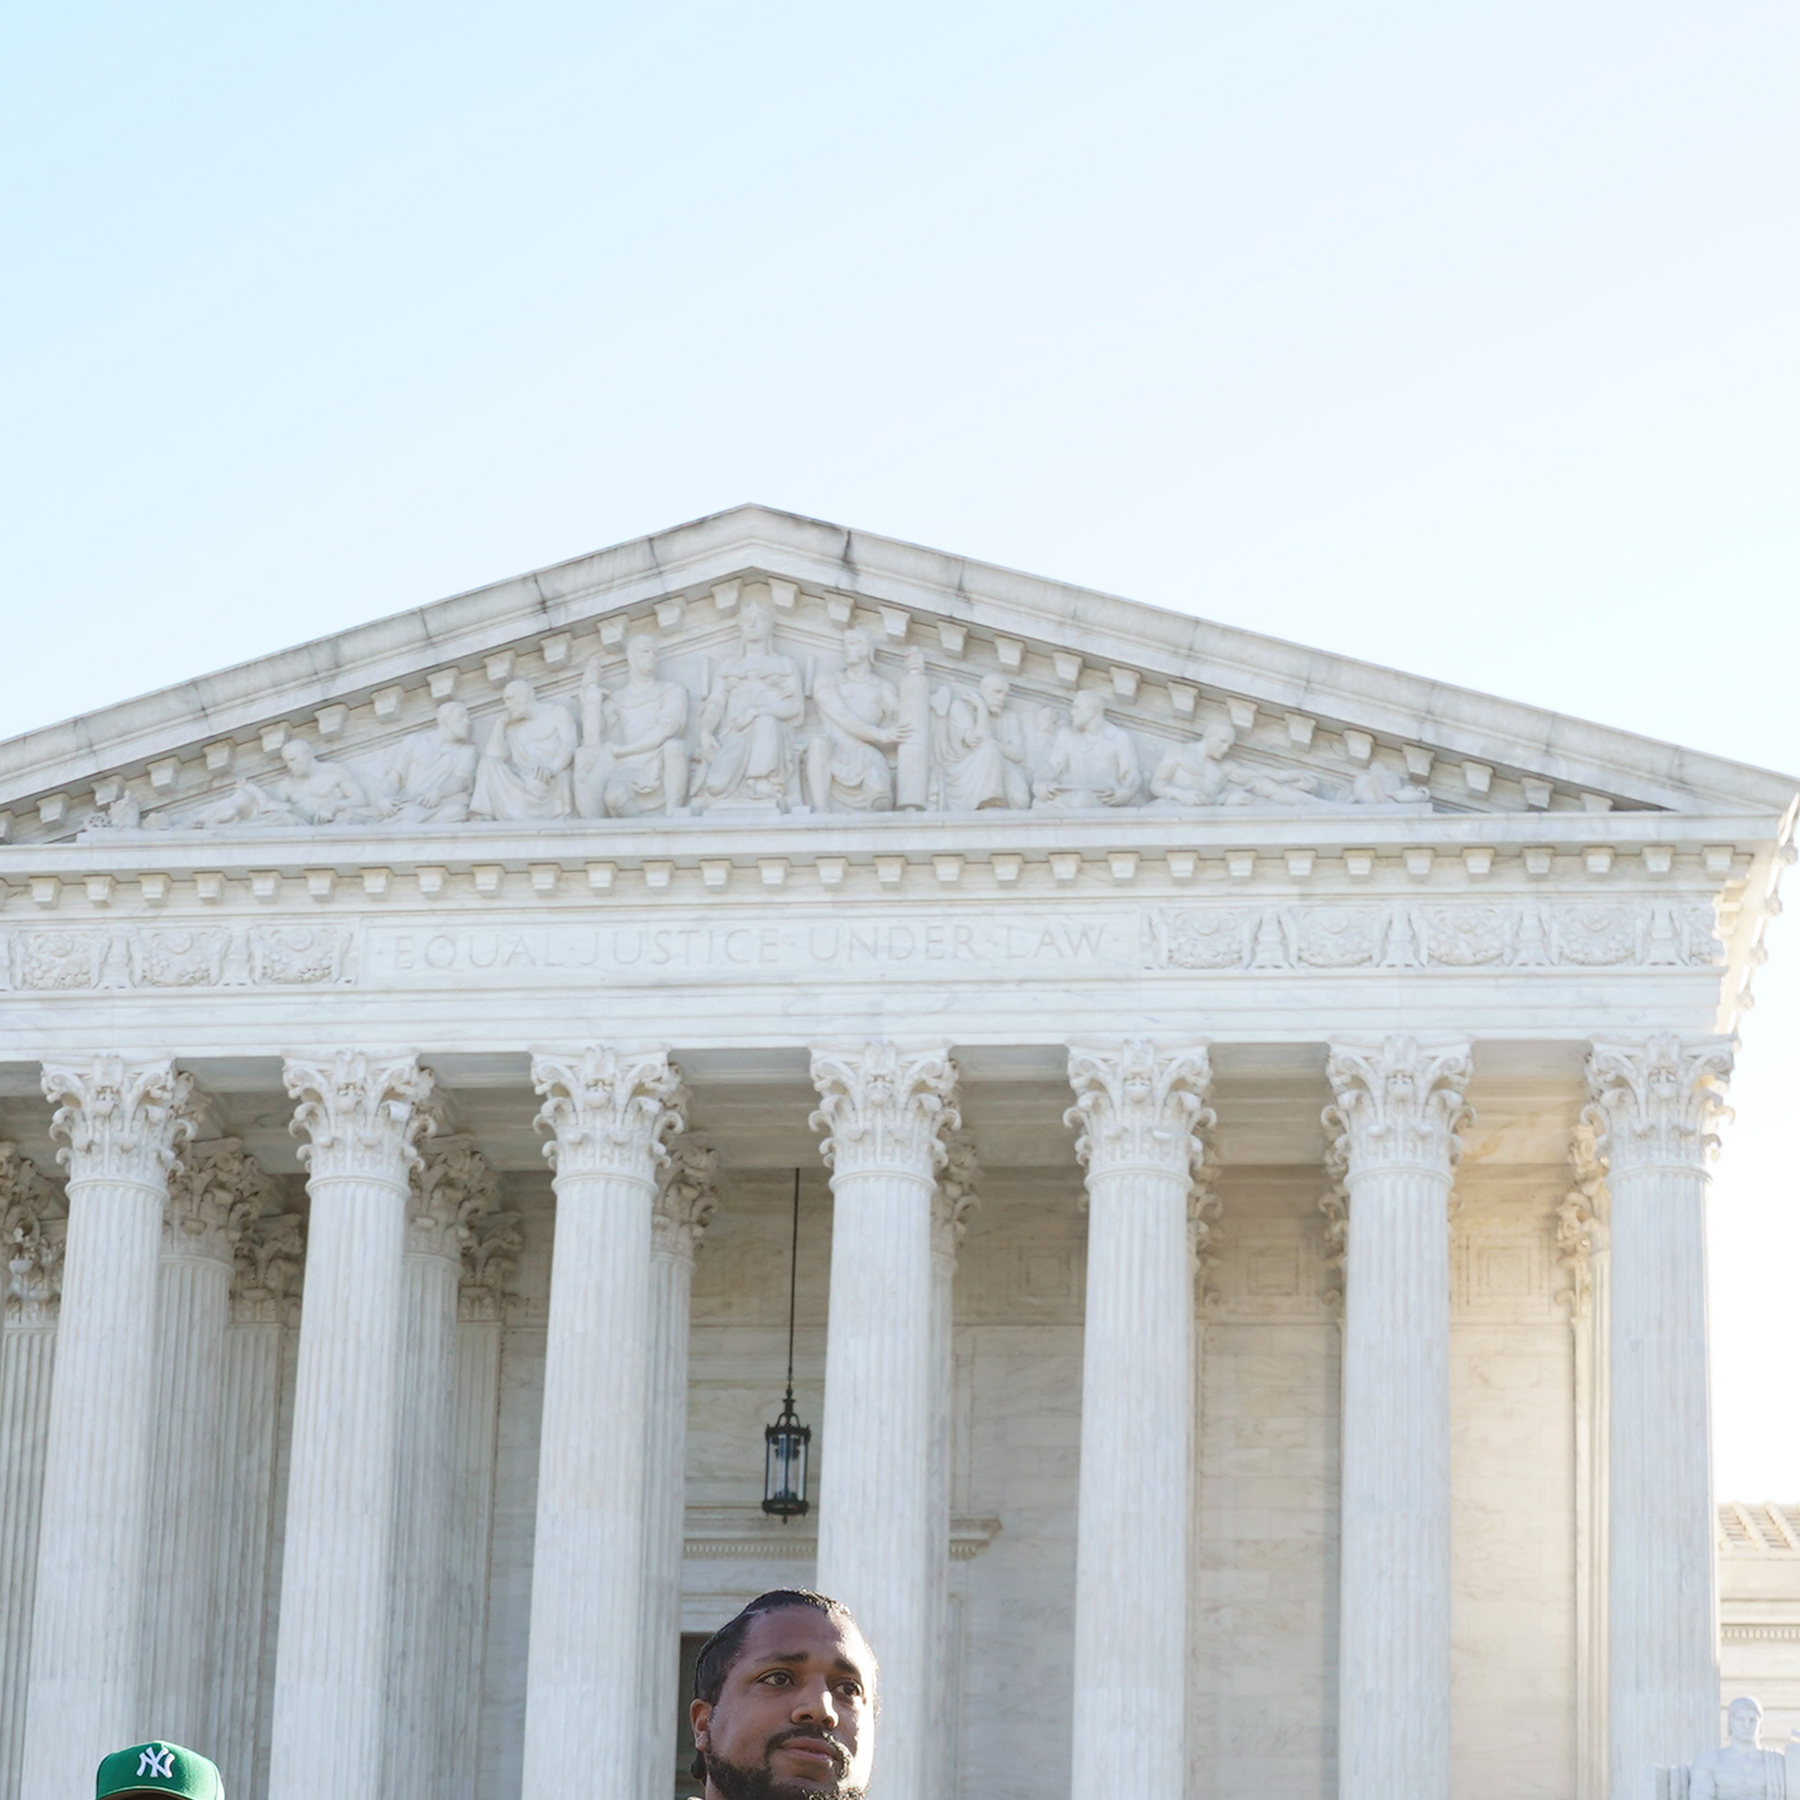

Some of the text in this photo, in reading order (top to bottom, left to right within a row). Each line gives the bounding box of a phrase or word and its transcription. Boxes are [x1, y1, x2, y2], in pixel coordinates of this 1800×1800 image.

[393, 924, 1104, 972] EQUAL JUSTICE UNDER LAW
